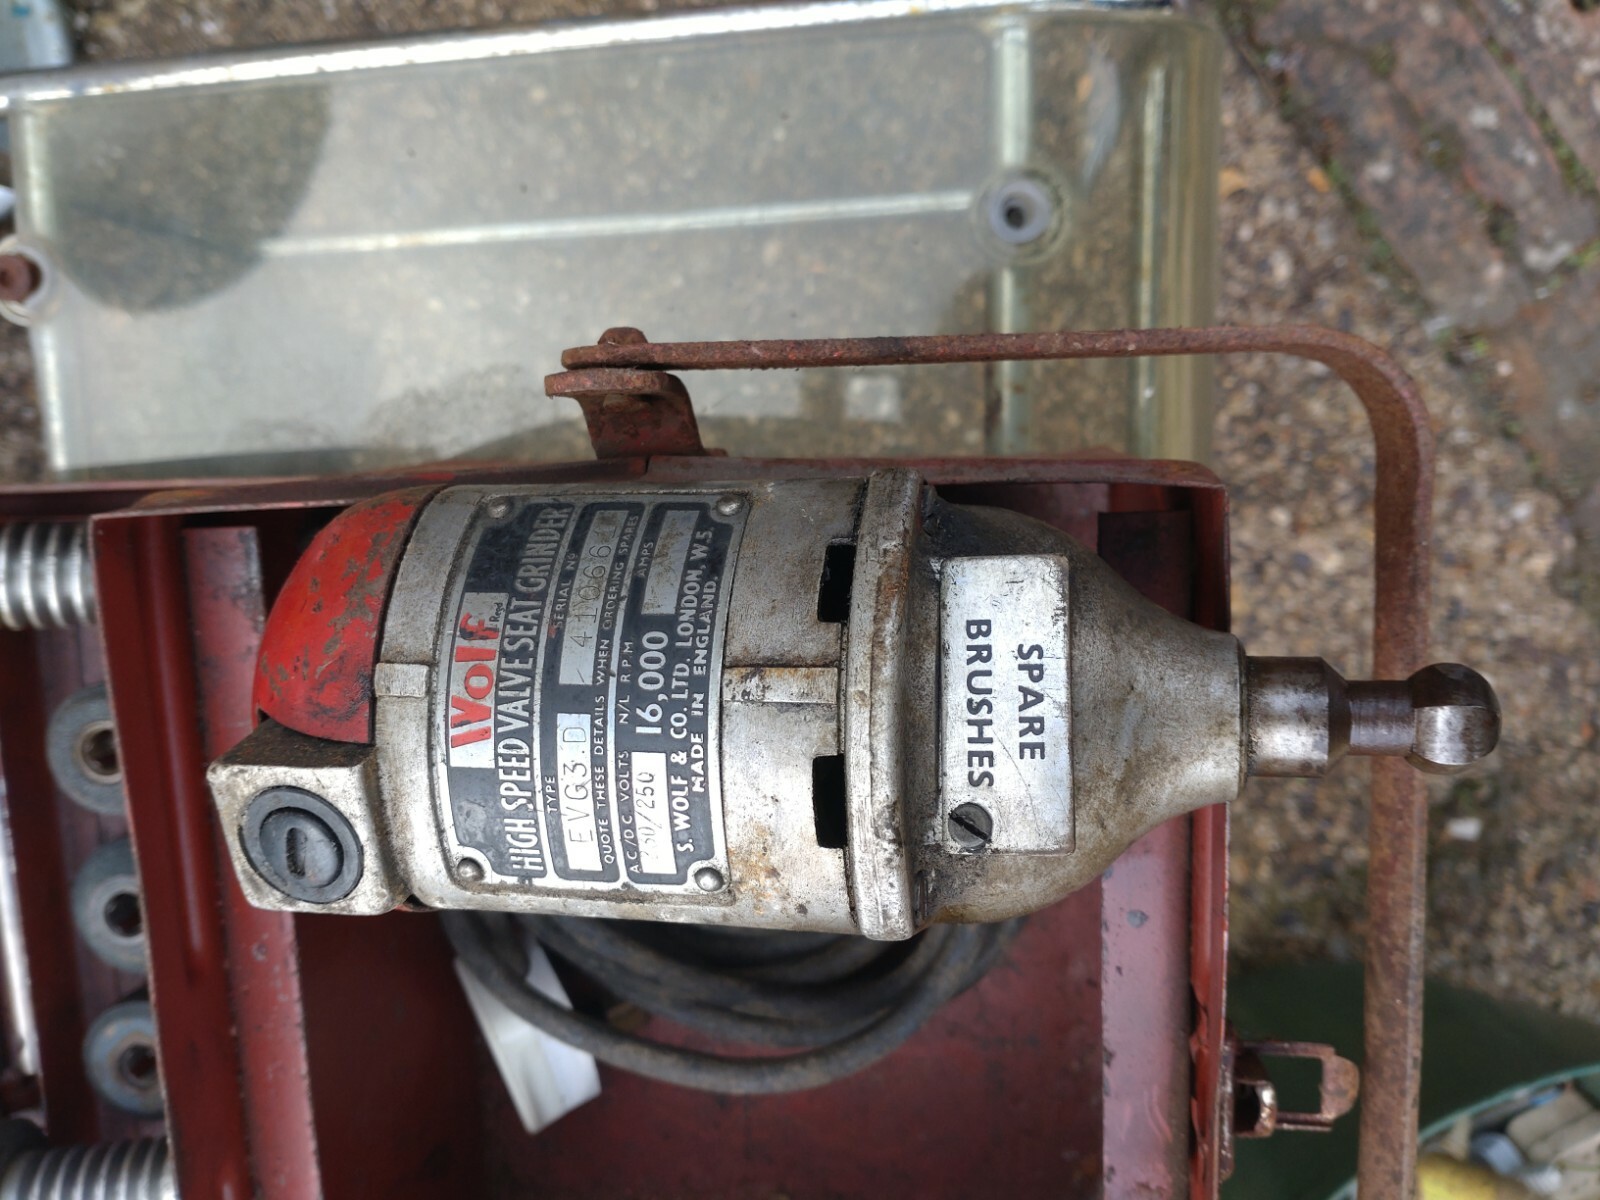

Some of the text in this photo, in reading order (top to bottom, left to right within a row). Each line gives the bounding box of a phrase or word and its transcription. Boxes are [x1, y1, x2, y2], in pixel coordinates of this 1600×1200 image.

[637, 542, 654, 578] AMPS
[554, 579, 573, 630] SERIAL
[497, 506, 573, 871] HIGH SPEED VALVE SEAT GRINDER
[593, 515, 639, 864] QUOTE THESE DETAILS WHEN ORDERING SPARES
[635, 631, 669, 734] 16,000
[671, 658, 691, 699] LTD.
[691, 576, 719, 793] MADE IN ENGLAND.
[965, 619, 995, 788] BRUSHES
[1017, 643, 1046, 760] SPARE
[617, 694, 631, 724] N/L
[670, 707, 688, 739] CO.
[618, 751, 630, 802] VOLTS
[670, 751, 688, 765] &
[544, 776, 557, 814] TYPE
[671, 775, 691, 832] WOLF
[676, 838, 695, 852] S.
